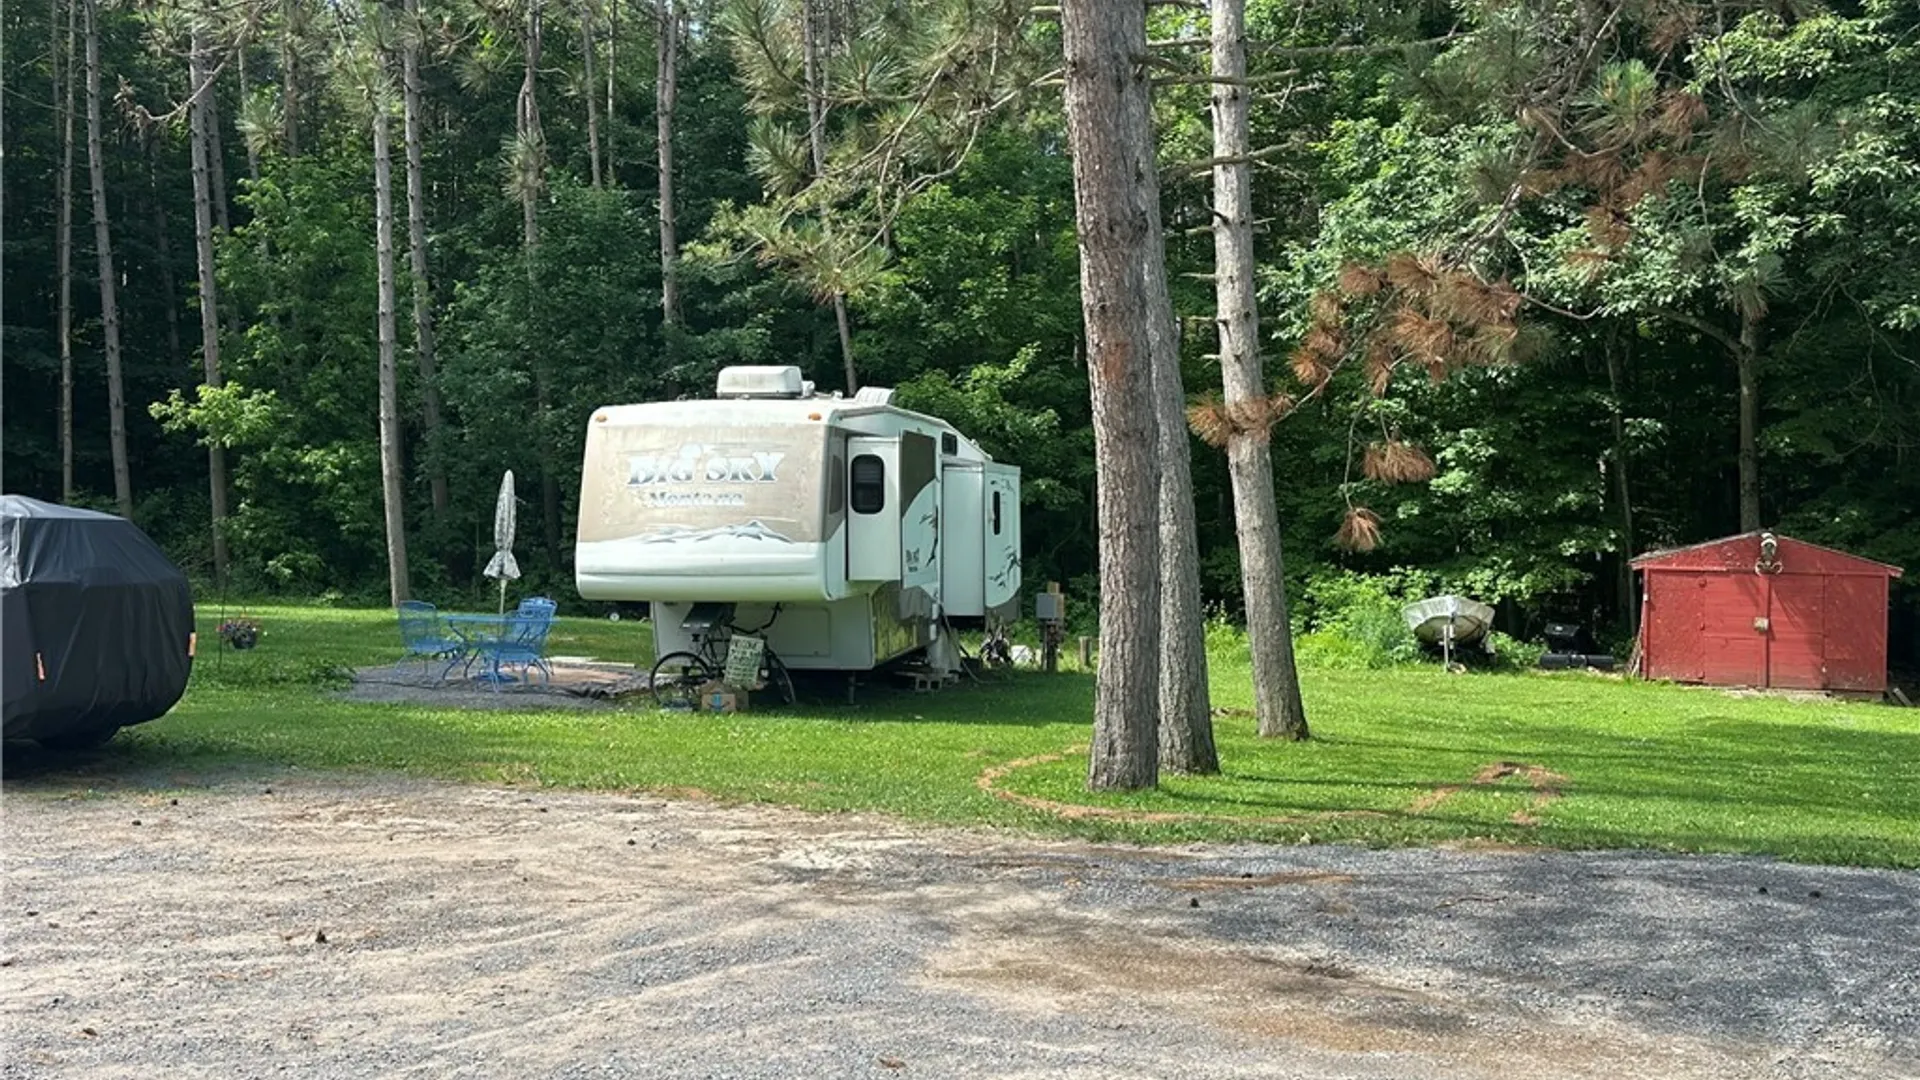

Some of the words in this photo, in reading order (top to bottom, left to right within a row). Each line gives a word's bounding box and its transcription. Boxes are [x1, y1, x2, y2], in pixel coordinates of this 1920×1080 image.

[627, 454, 696, 487] BIG
[705, 451, 785, 484] SKY
[647, 490, 745, 507] Montana
